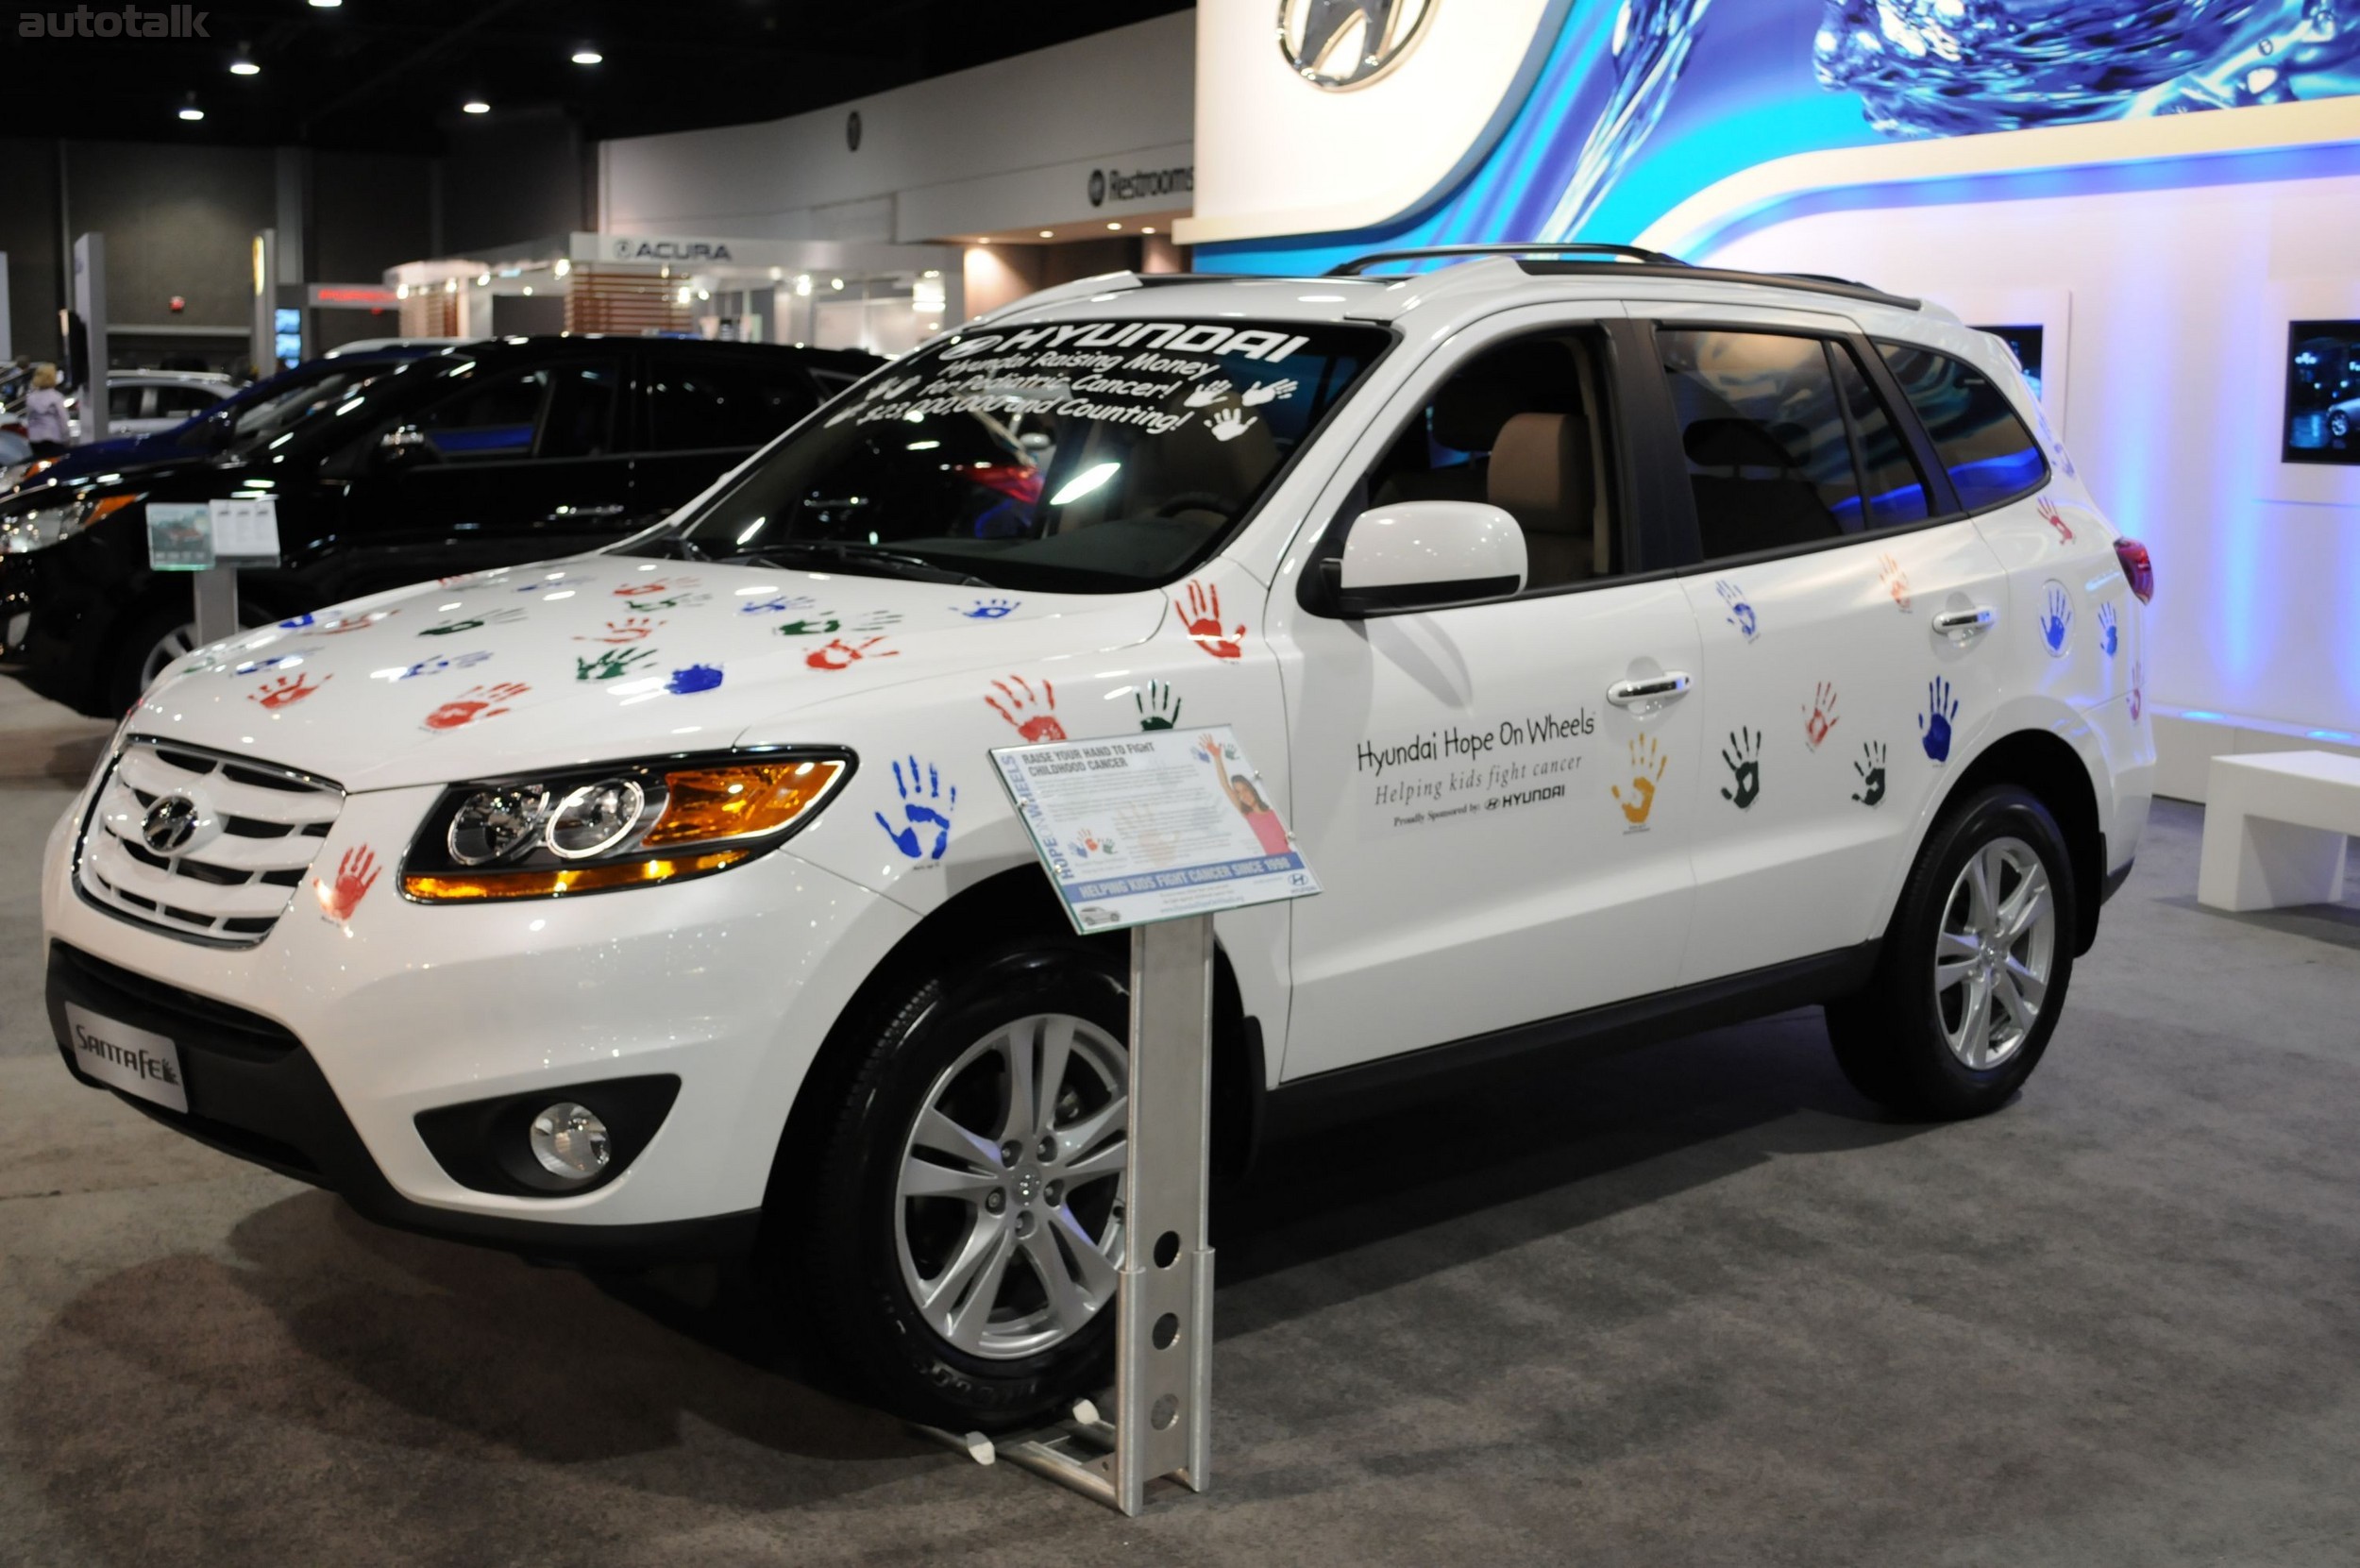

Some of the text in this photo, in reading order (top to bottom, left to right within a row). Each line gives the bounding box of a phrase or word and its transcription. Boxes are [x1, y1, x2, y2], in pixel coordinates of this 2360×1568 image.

[1108, 166, 1194, 200] Restrooms
[636, 242, 733, 261] ACURA
[993, 323, 1310, 362] HYUNDAI
[936, 350, 1222, 381] Hyundai Raising Money
[956, 372, 1071, 391] Pediatric
[1070, 374, 1184, 399] Cancer!
[1004, 396, 1066, 413] and
[1056, 397, 1196, 434] Counting!
[1021, 742, 1155, 765] RAISE YOUR HAND TO FIGHT
[1357, 708, 1594, 777] Hyundai Hope On Wheels
[1028, 757, 1129, 777] CHILDHOOD CANCER
[1374, 756, 1582, 805] Helping kids fight cancer
[1393, 813, 1424, 827] Proudly
[1427, 803, 1467, 822] Sponsored
[1502, 784, 1566, 809] HYUNDAI
[1079, 881, 1130, 899] HELPING
[1128, 877, 1156, 891] KIDS
[1155, 872, 1188, 887] FIGHT
[1188, 866, 1233, 883] CANCER
[1231, 860, 1265, 876] SINCE
